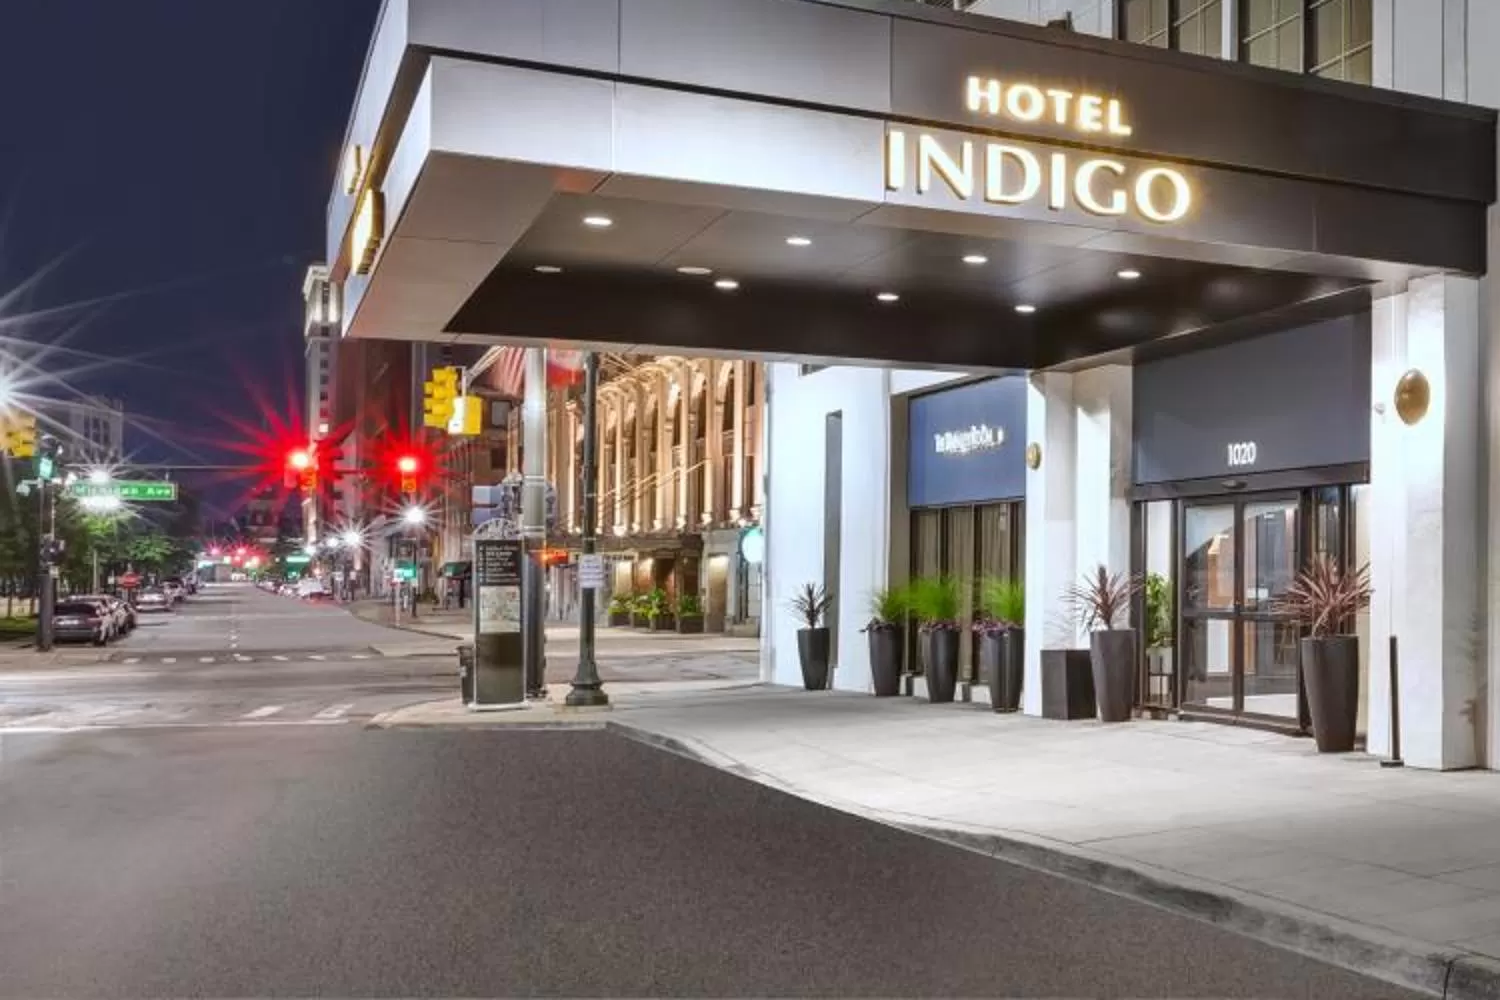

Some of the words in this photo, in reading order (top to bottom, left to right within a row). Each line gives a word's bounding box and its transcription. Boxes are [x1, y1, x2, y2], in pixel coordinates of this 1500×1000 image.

[966, 75, 1133, 136] HOTEL
[885, 130, 1191, 222] INDIGO
[1227, 441, 1257, 466] 1020
